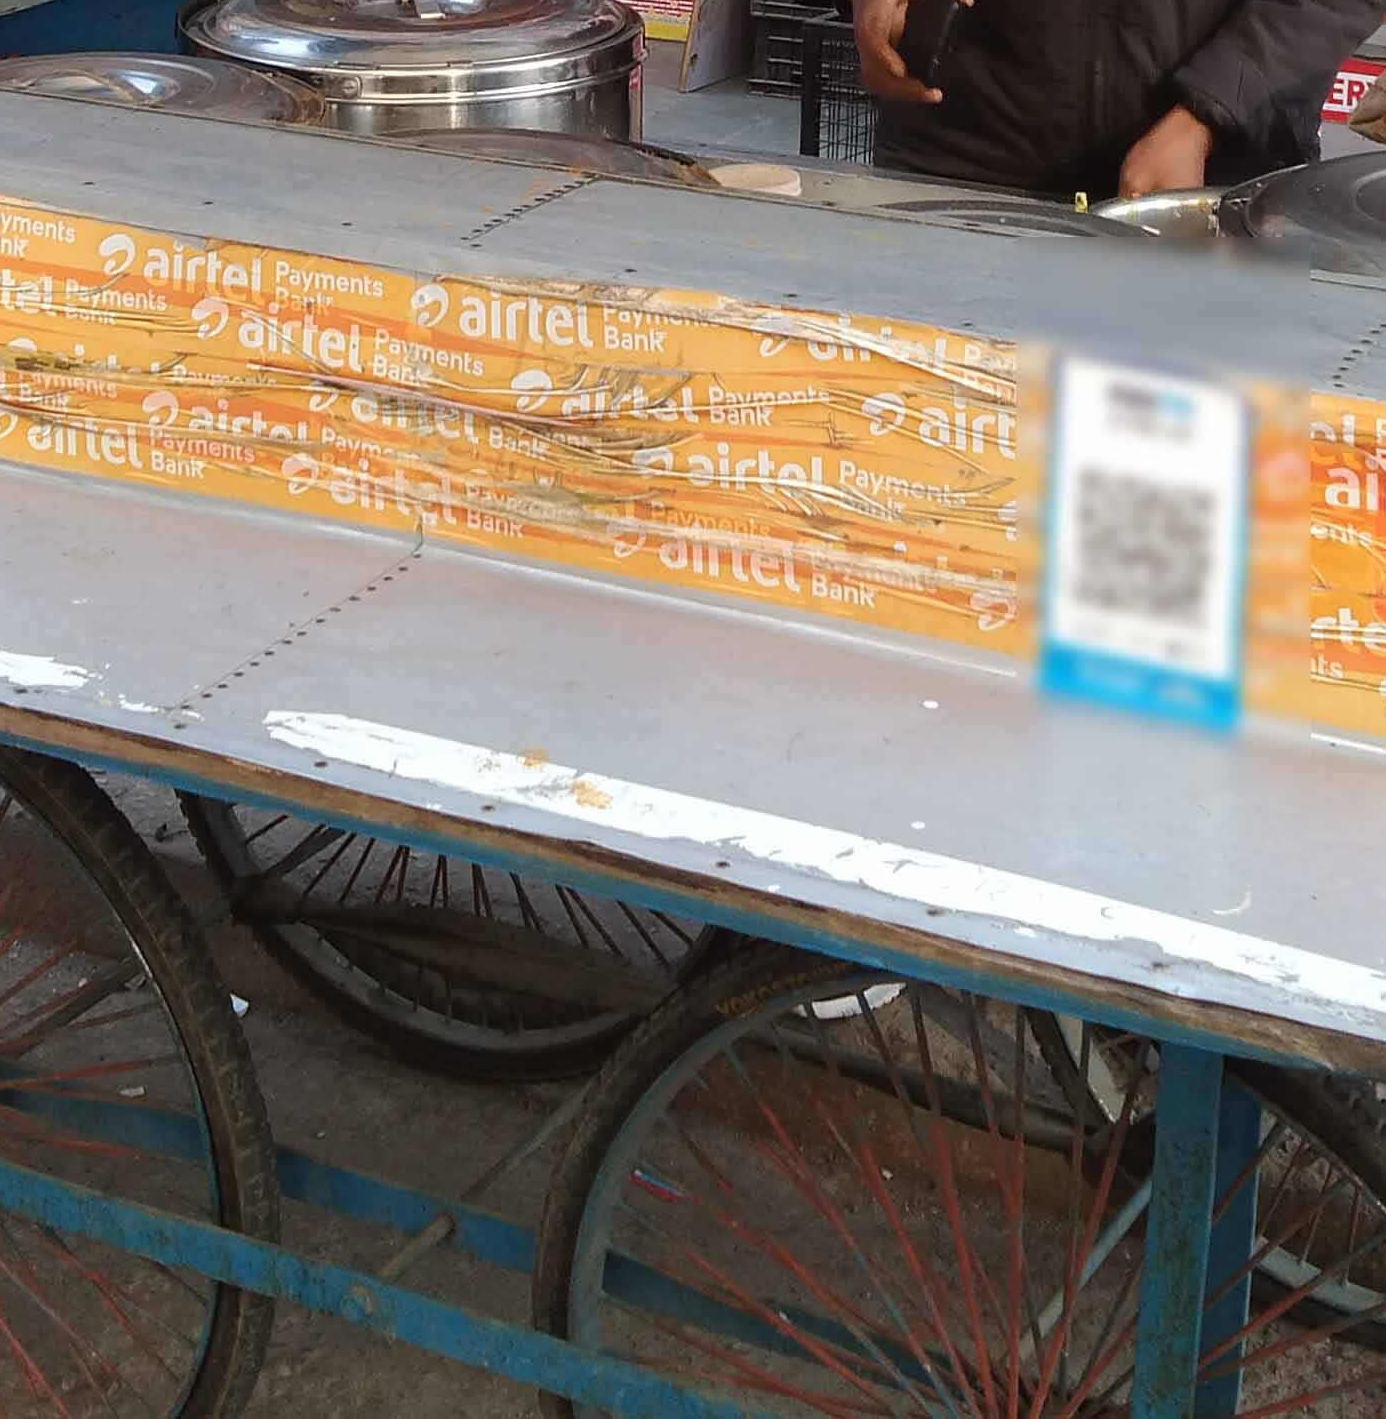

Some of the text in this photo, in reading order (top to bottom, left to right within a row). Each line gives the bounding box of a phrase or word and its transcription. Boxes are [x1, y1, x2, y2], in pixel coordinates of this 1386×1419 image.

[143, 241, 384, 306] airtel Payments
[238, 303, 484, 377] airtel Payments
[459, 291, 593, 349] airtel
[604, 325, 667, 353] Bank
[27, 410, 142, 470] airtel
[151, 450, 205, 478] Bank
[465, 506, 525, 538] Bank
[659, 530, 801, 594] airtel
[811, 574, 877, 609] Bank
